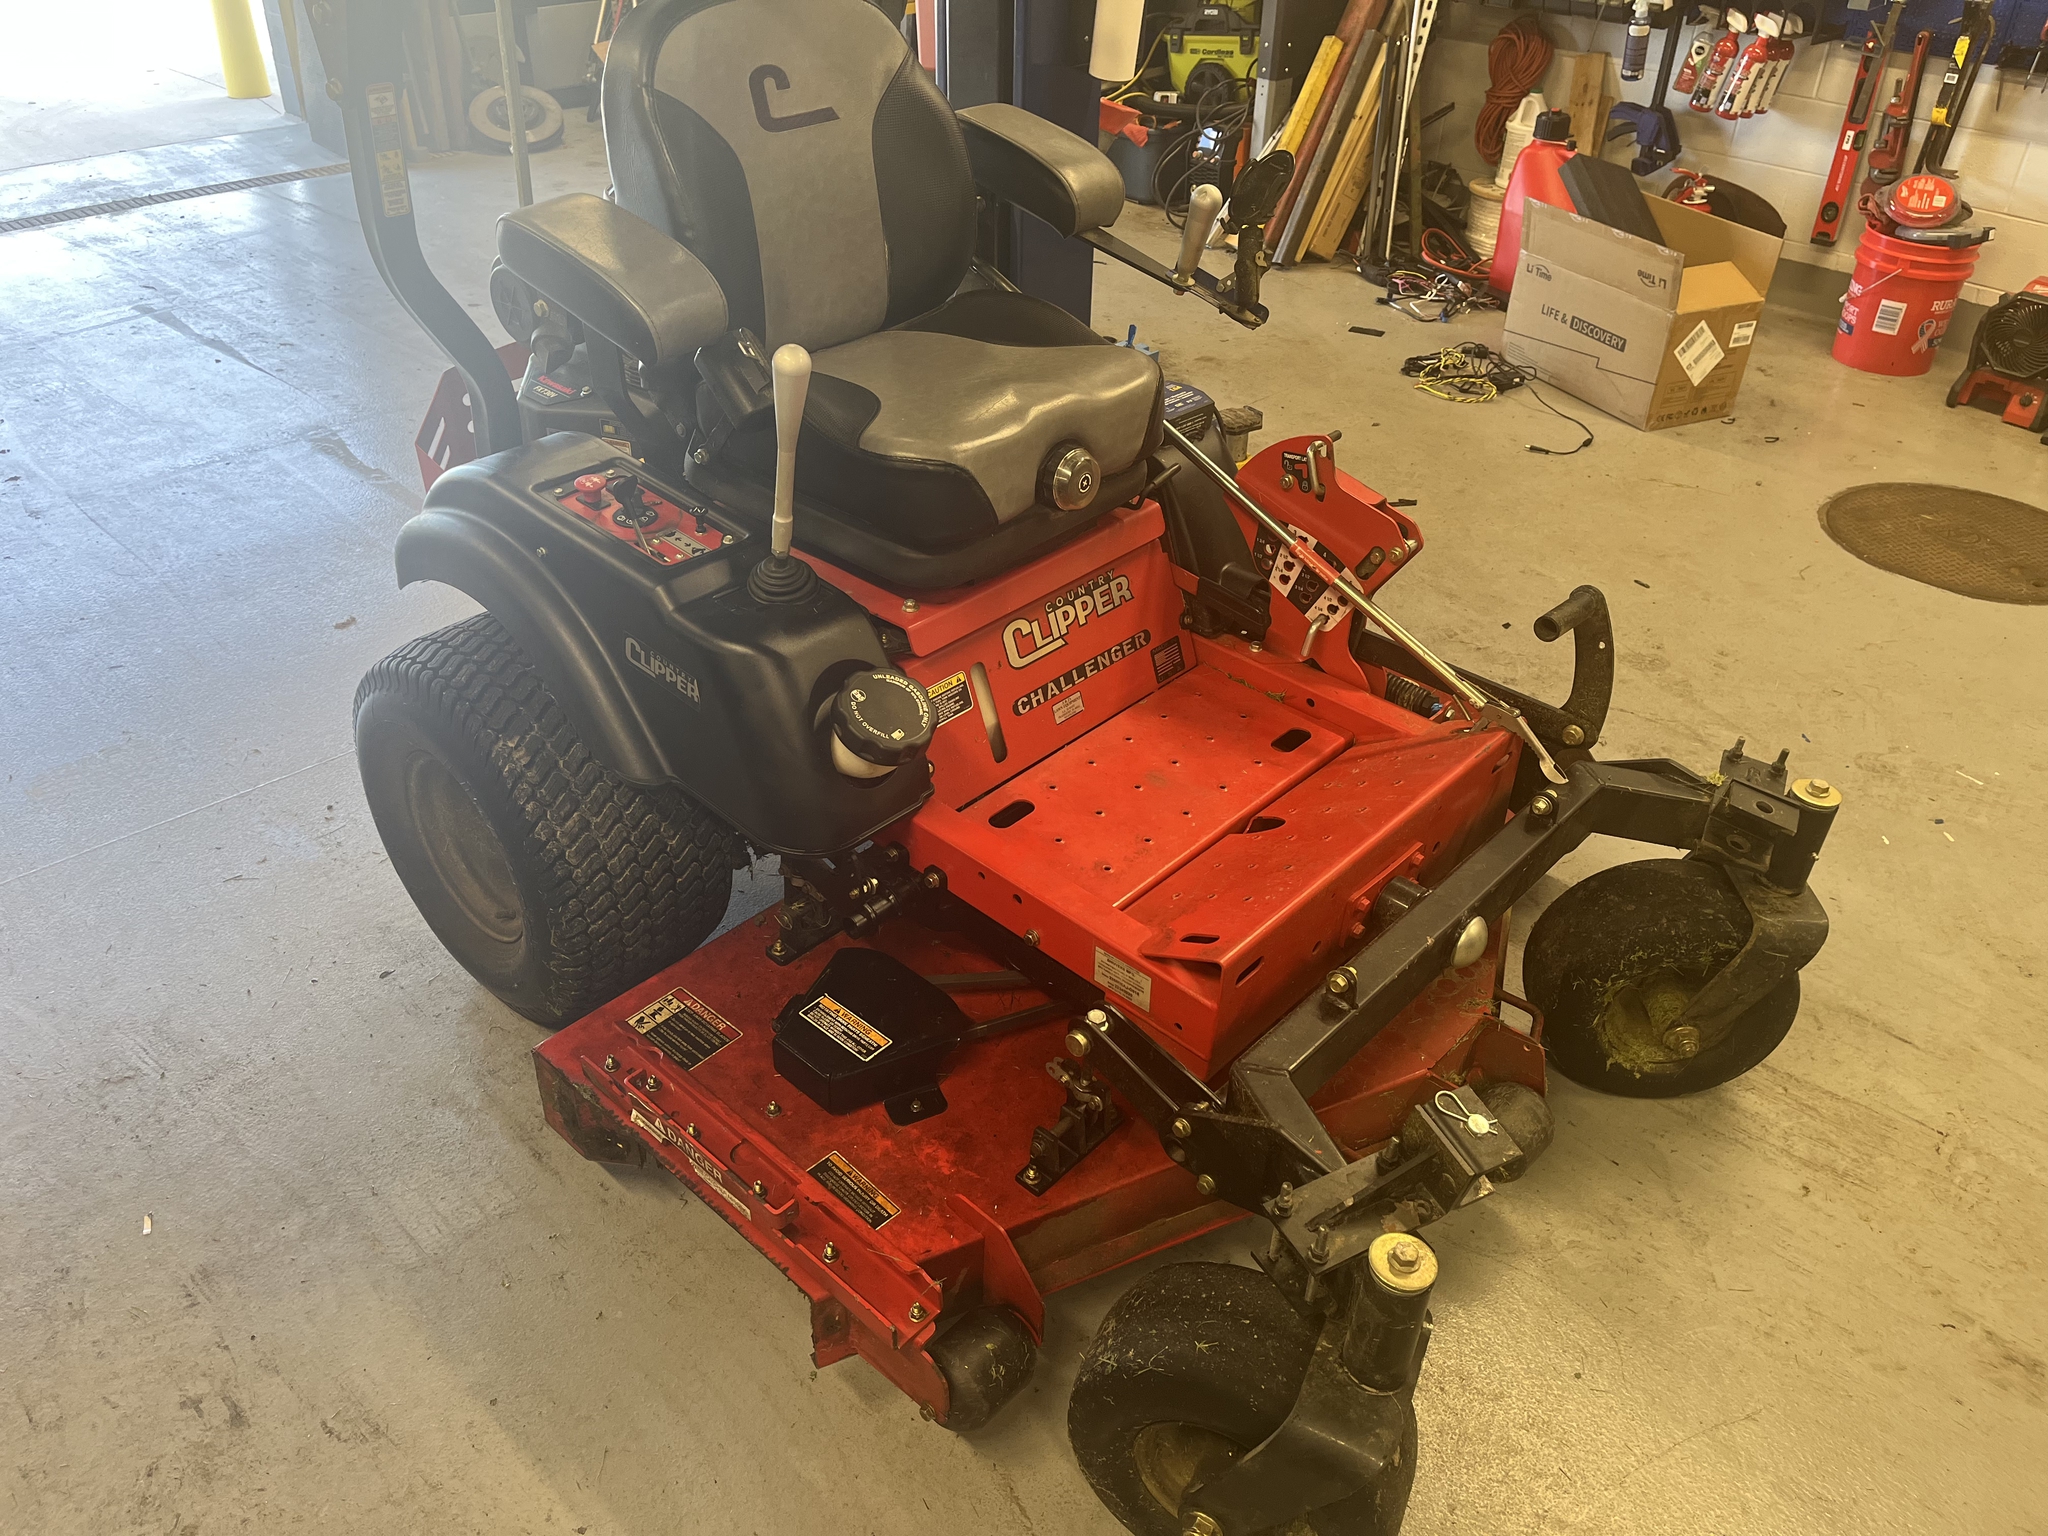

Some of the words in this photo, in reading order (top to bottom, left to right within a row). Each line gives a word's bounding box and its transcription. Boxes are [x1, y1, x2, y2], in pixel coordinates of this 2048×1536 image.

[1541, 304, 1560, 321] LIFE
[1560, 313, 1568, 324] &
[1572, 318, 1625, 350] DISCOVERY
[538, 375, 576, 395] Kawasaki
[1046, 570, 1114, 612] COUNTRY
[650, 650, 692, 682] COUNTRY
[1018, 632, 1147, 714] CHALLENGER
[872, 674, 908, 686] UNLEADED
[908, 684, 928, 712] GASOLINE
[921, 712, 929, 728] ONLY
[850, 702, 858, 710] DO
[854, 711, 863, 722] NOT
[862, 722, 890, 739] OVERFILL
[692, 1002, 726, 1031] DANGER
[842, 1012, 872, 1036] WARNING
[667, 1128, 723, 1184] DANGER
[852, 1174, 880, 1198] WARNING
